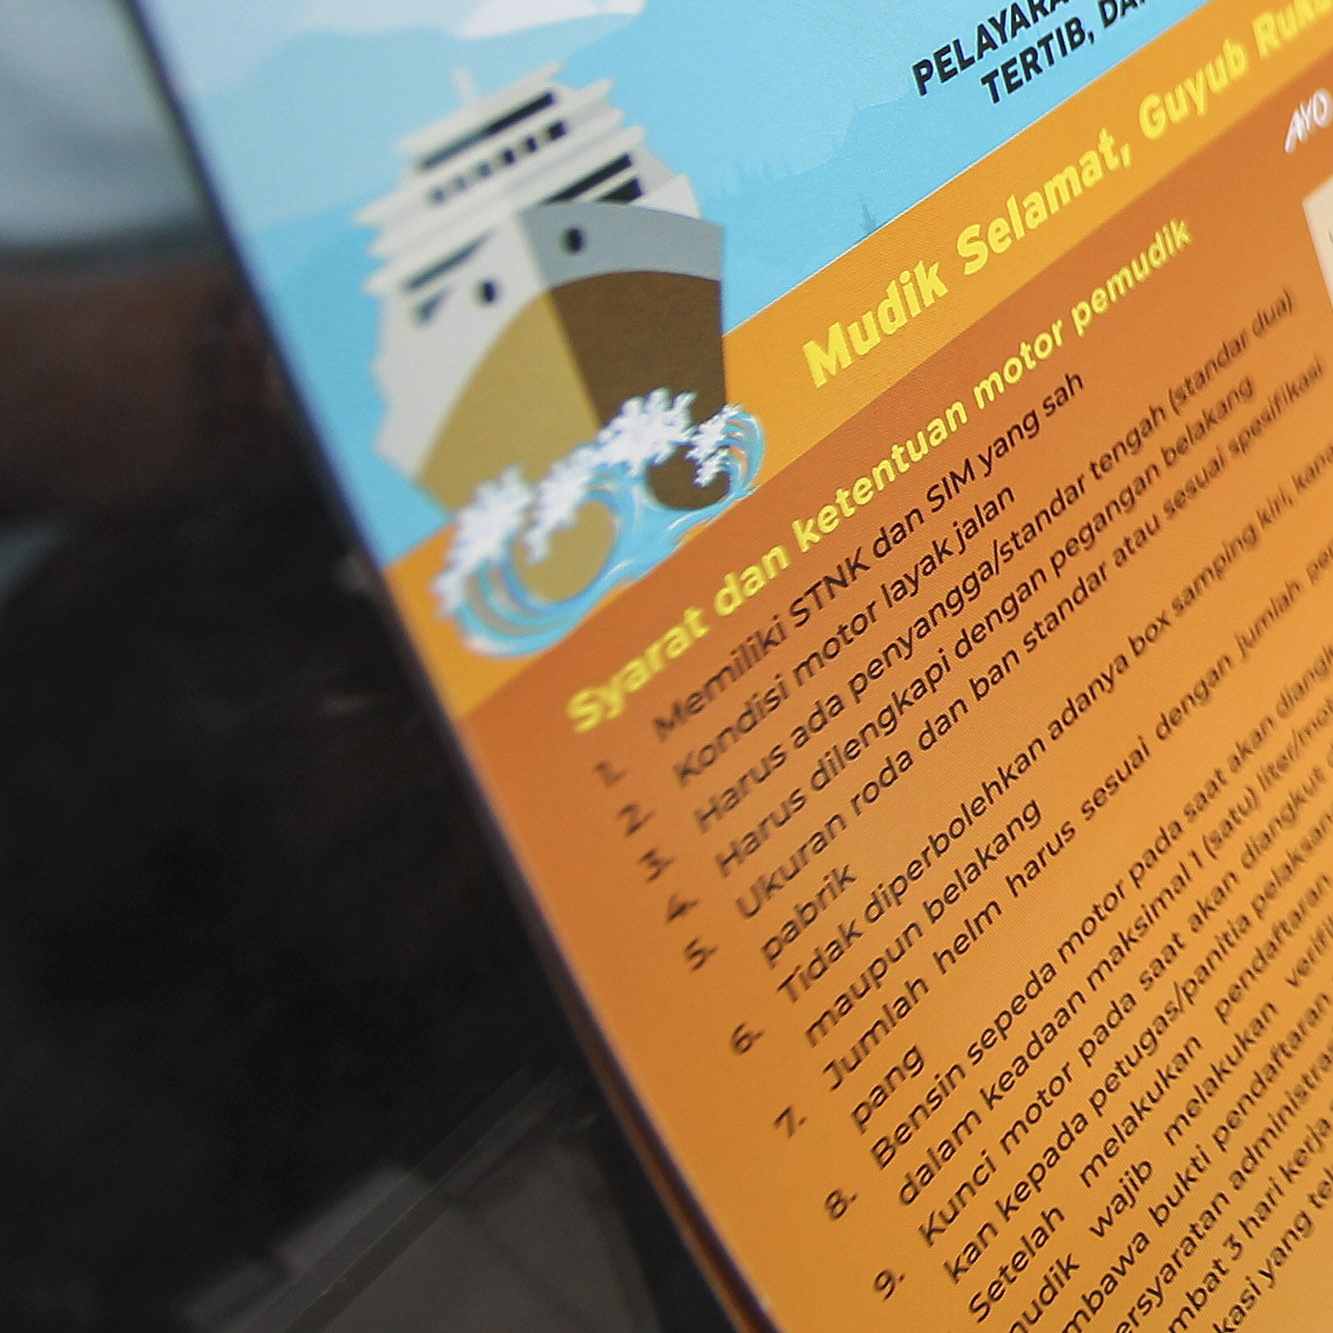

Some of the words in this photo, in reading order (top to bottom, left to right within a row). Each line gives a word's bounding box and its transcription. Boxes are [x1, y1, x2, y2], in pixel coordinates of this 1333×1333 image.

[801, 259, 949, 389] Mudik
[956, 126, 1131, 275] Selamat,
[1138, 38, 1247, 139] Guyub
[979, 15, 1095, 104] TERTIB,
[1283, 90, 1329, 152] AYO
[567, 607, 709, 732] Syarat
[714, 545, 789, 616] dan
[791, 400, 968, 553] ketentuan
[972, 318, 1063, 410] motor
[1070, 219, 1190, 336] pemudik
[636, 847, 673, 883] 3.
[693, 742, 787, 834] Harus
[788, 693, 845, 749] ada
[846, 472, 1085, 705] penyangga/standar
[1088, 404, 1166, 481] tengah
[1167, 328, 1247, 417] (standar
[1250, 288, 1293, 337] dua)
[651, 613, 787, 742] Memiliki
[788, 545, 871, 628] STNK
[871, 507, 925, 559] dan
[925, 456, 976, 514] SIM
[976, 408, 1040, 478] yang
[1041, 372, 1084, 418] sah
[665, 895, 698, 924] 4.
[713, 786, 807, 878] Harus
[809, 646, 951, 791] dilengkapi
[953, 567, 1048, 659] dengan
[1048, 462, 1160, 579] pegangan
[1159, 375, 1254, 469] belakang
[616, 802, 654, 838] 2.
[672, 672, 789, 788] Kondisi
[791, 599, 877, 687] motor
[879, 536, 954, 609] layak
[951, 486, 1015, 556] jalan
[683, 937, 718, 972] 5.
[734, 812, 847, 919] Ukuran
[849, 749, 914, 817] roda
[917, 697, 969, 751] dan
[967, 648, 1020, 702] ban
[1021, 560, 1107, 654] standar
[1111, 512, 1161, 568] atau
[1161, 445, 1226, 521] sesuai
[1227, 357, 1323, 457] spesifikasi
[730, 1022, 763, 1055] 6.
[775, 918, 864, 1003] Tidak
[863, 737, 1046, 924] diperbolehkan
[1046, 653, 1129, 741] adanya
[1126, 609, 1171, 658] box
[1170, 522, 1259, 618] samping
[759, 863, 857, 970] pabrik
[772, 1104, 806, 1139] 7.
[821, 977, 929, 1092] Jumlah
[931, 899, 1003, 975] helm
[1004, 819, 1076, 898] harus
[1079, 734, 1150, 821] sesuai
[1154, 653, 1232, 741] dengan
[1233, 580, 1302, 660] jumlah
[803, 921, 924, 1048] maupun
[921, 798, 1042, 925] belakang
[823, 1188, 857, 1220] 8.
[869, 1063, 966, 1171] Bensin
[966, 961, 1057, 1066] sepeda
[1056, 878, 1126, 964] motor
[1127, 819, 1183, 890] pada
[1182, 767, 1228, 823] saat
[1227, 714, 1275, 774] akan
[872, 1269, 905, 1301] 9.
[917, 1148, 997, 1248] Kunci
[998, 1060, 1073, 1156] motor
[1077, 991, 1137, 1068] pada
[1138, 931, 1186, 992] saat
[1187, 870, 1239, 934] akan
[1239, 766, 1326, 870] diangkut
[898, 1109, 982, 1206] dalam
[978, 989, 1086, 1111] keadaan
[1085, 861, 1191, 992] maksimal
[1189, 848, 1203, 868] 1
[1201, 785, 1259, 860] (satu)
[850, 1044, 925, 1135] pang
[942, 1221, 999, 1285] kan
[993, 1111, 1089, 1223] kepada
[1087, 914, 1251, 1118] petugas/panitia
[968, 1206, 1065, 1324] Setelah
[1078, 1035, 1202, 1189] melakukan
[1213, 873, 1330, 1026] pendaftaran
[1087, 1159, 1152, 1238] wajib
[1162, 1001, 1278, 1147] melakukan
[1147, 1143, 1211, 1228] bukti
[1210, 992, 1330, 1153] pendaftaran
[1221, 1232, 1243, 1262] 3
[1237, 1175, 1284, 1239] hari
[1277, 1117, 1332, 1184] kerja
[1256, 1209, 1312, 1289] yang
